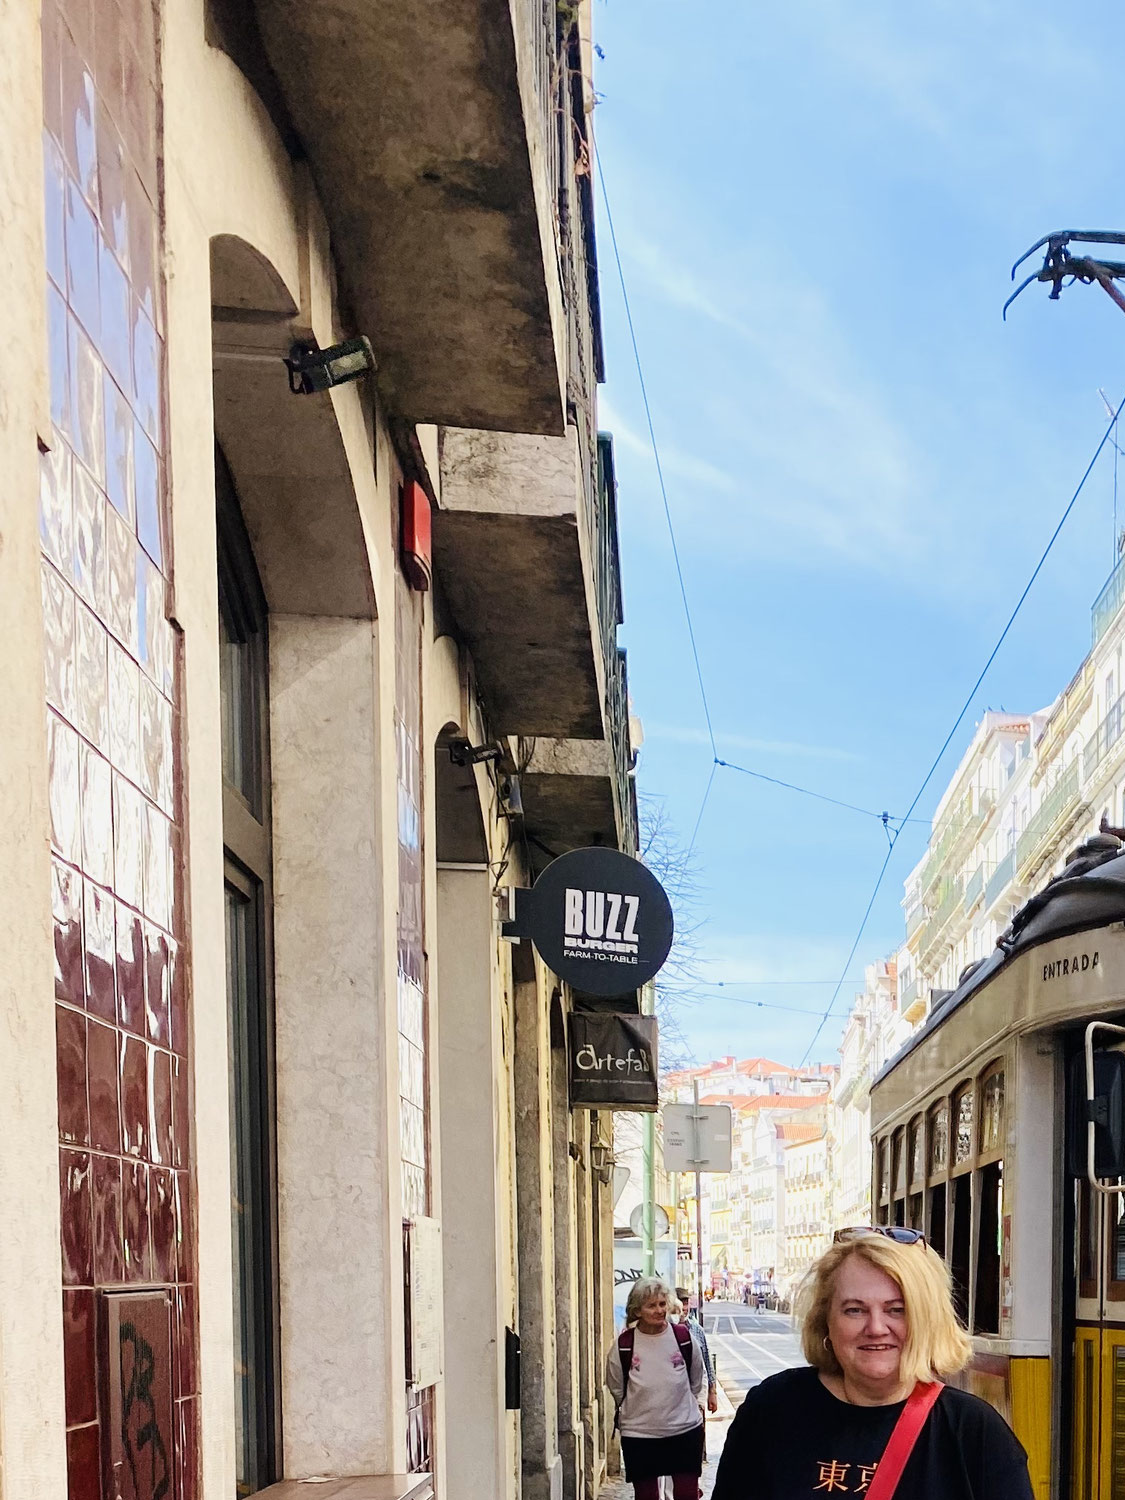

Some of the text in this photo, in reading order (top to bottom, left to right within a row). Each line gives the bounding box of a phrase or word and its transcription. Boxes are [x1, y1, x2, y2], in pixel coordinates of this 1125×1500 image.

[565, 887, 640, 943] BUZZ
[563, 949, 639, 965] FARM-TO-TABLE
[564, 936, 639, 954] BURGER
[1043, 951, 1100, 982] ENTRADA
